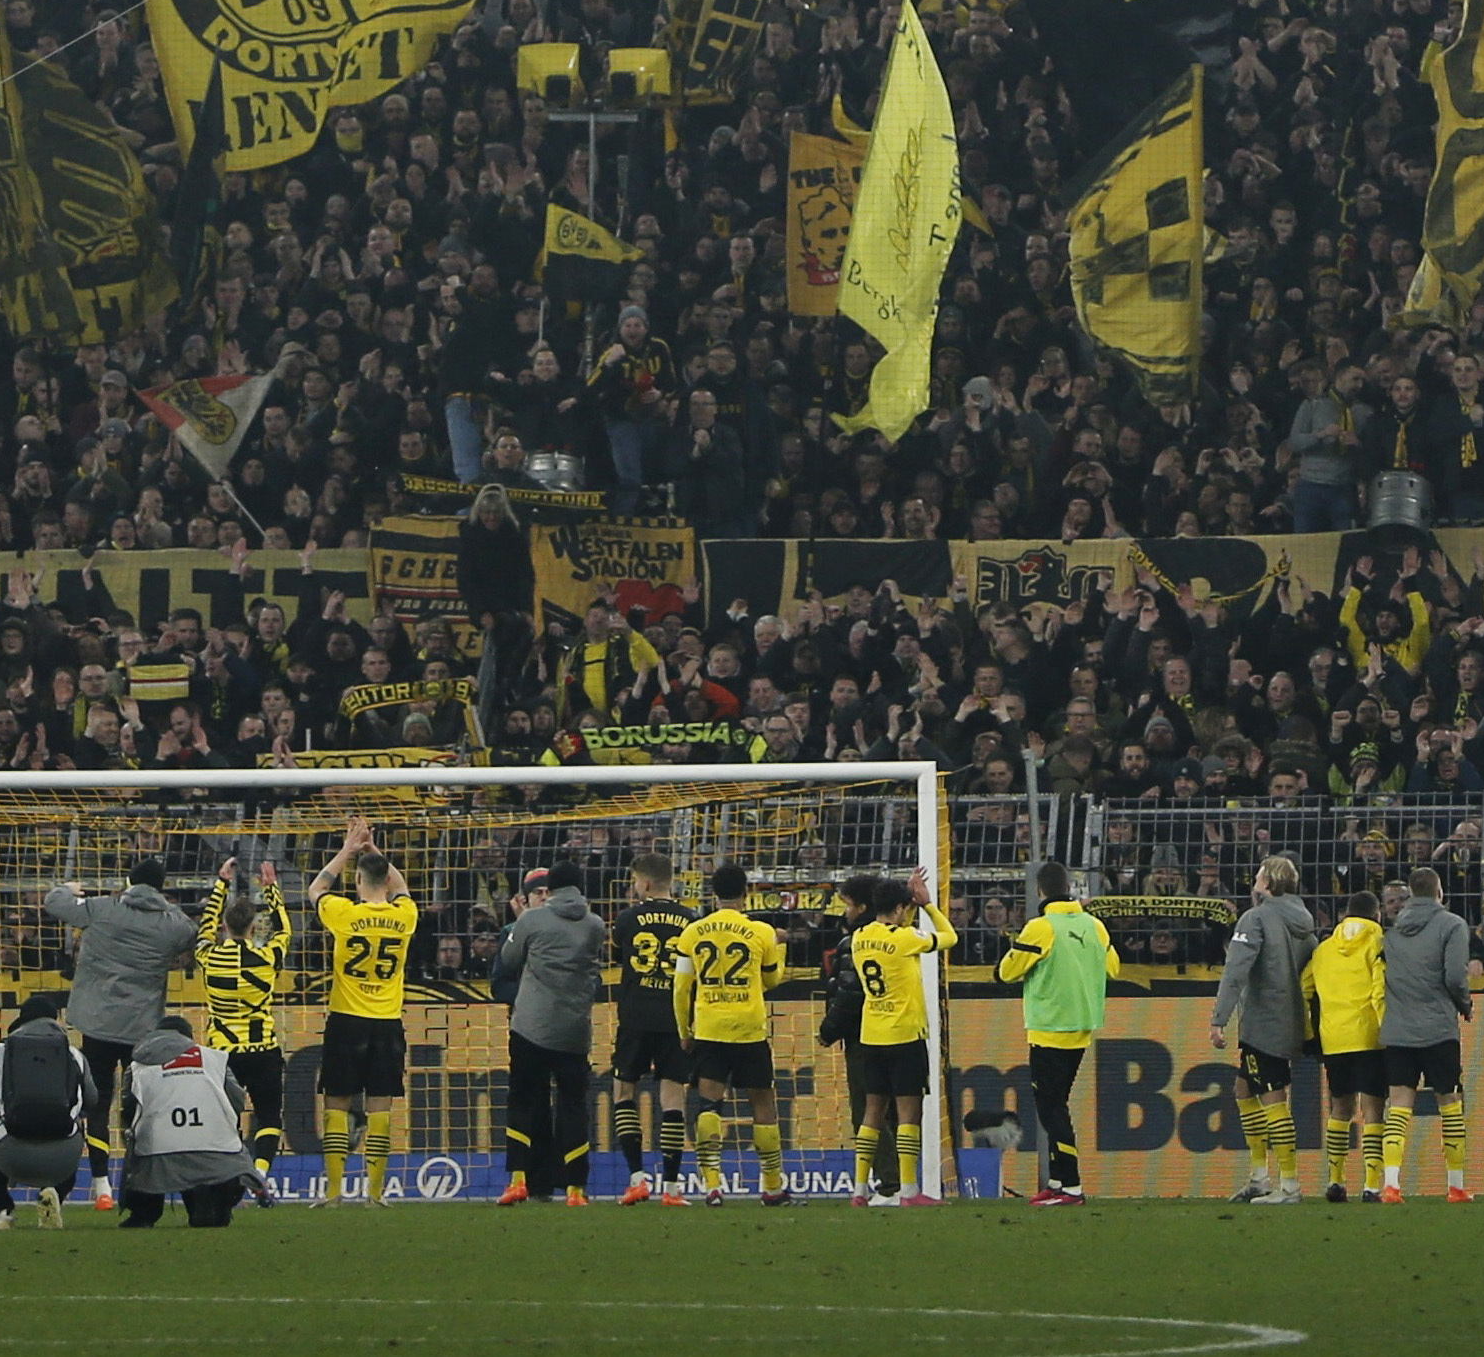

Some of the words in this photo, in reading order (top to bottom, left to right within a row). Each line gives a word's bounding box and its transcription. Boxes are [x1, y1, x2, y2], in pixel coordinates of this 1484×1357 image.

[548, 527, 684, 564] WESTFALEN
[571, 557, 666, 582] STADION
[579, 722, 731, 749] BORUSSIA
[350, 917, 406, 933] DORTMUND
[697, 922, 754, 940] DORTMUND
[344, 936, 403, 980] 25
[853, 942, 896, 955] DORTMUND
[695, 941, 751, 987] 22
[862, 959, 887, 998] 8
[171, 1107, 203, 1127] 01
